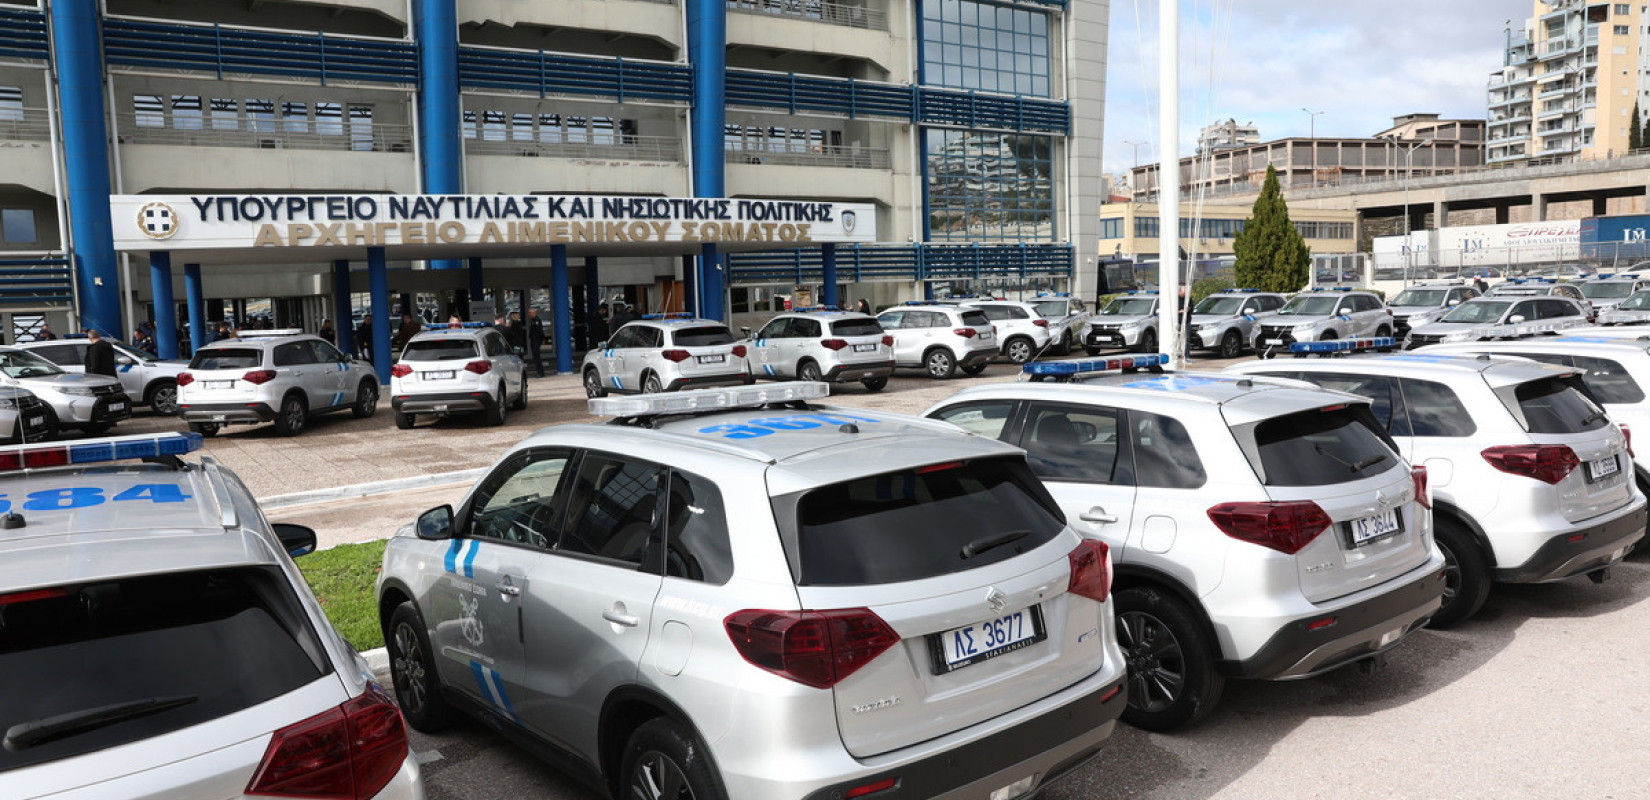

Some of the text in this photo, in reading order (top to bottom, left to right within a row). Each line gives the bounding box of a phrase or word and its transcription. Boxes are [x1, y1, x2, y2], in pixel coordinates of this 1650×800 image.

[191, 196, 834, 222] ΥΠΟΥΡΓΕΙΟ ΝΑΥΤΙΛΙΑΣ ΚΑΙ ΝΗΣΙΩΤΙΚΗΣ ΠΟΛΙΤΙΚΗΣ
[253, 221, 813, 247] ΑΡΧΗΓΕΙΟ ΛΙΜΕΝΙΚΟΥ ΣΩΜΑΤΟΣ
[0, 484, 192, 514] 84
[954, 611, 1022, 658] ΛΣ 3677
